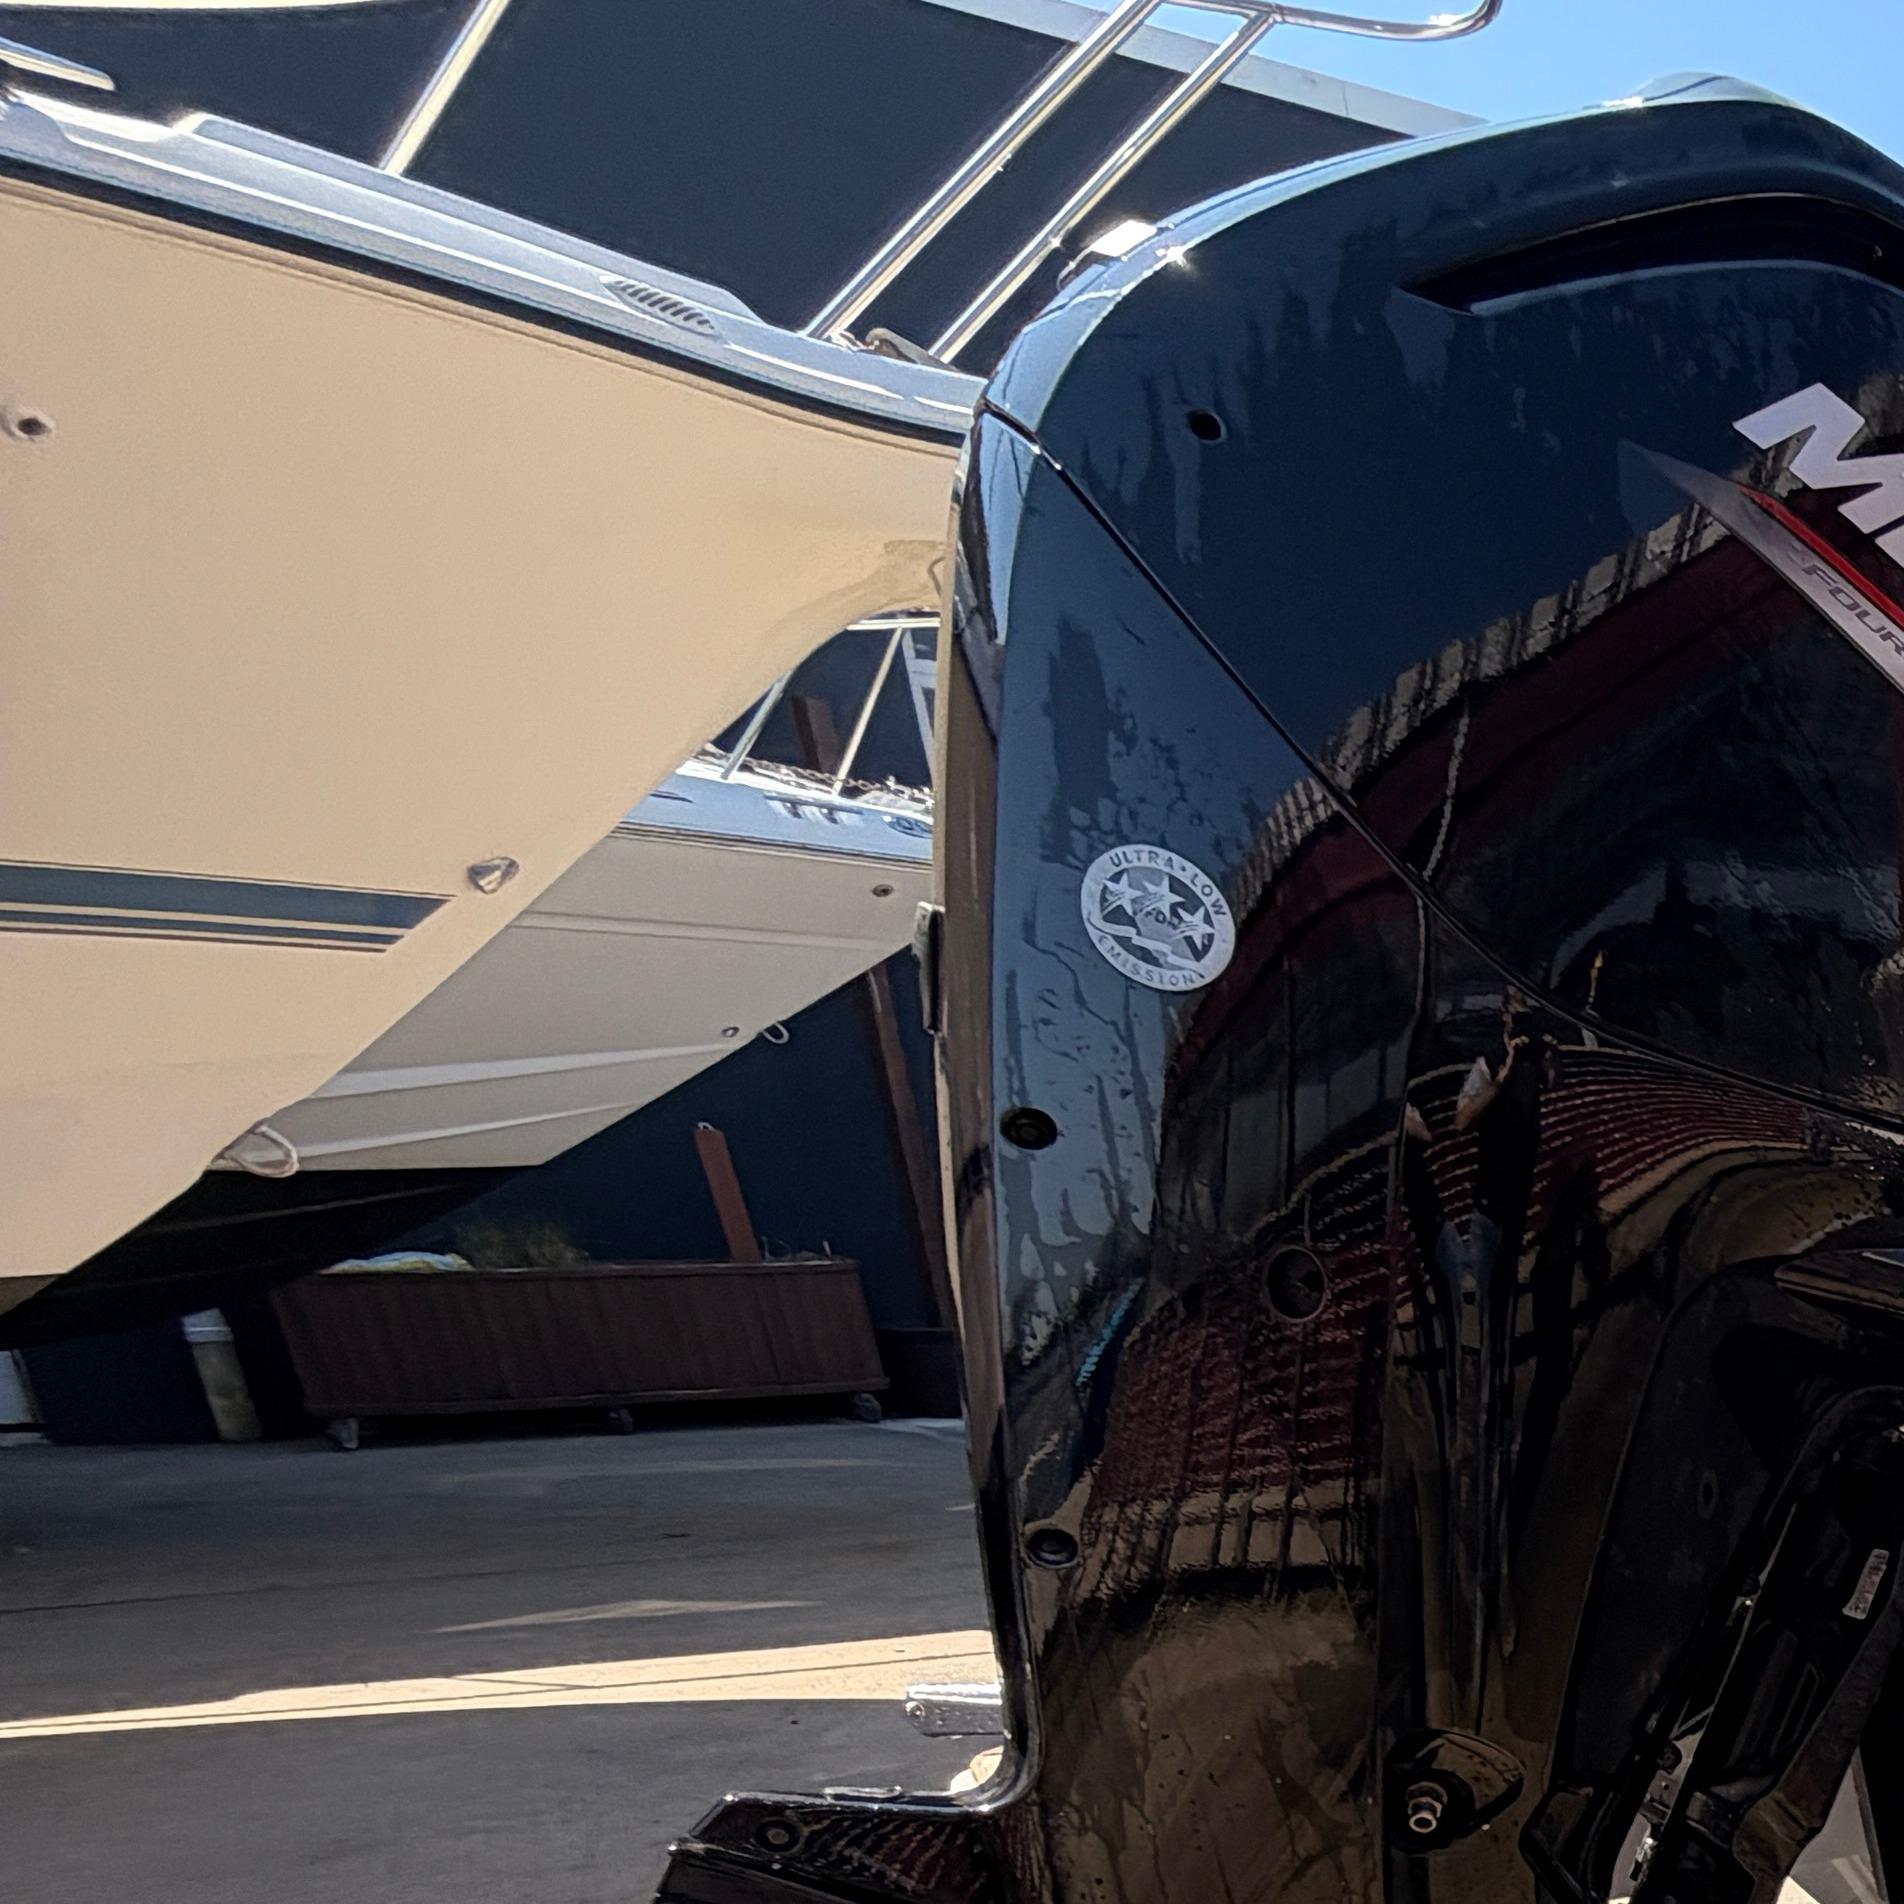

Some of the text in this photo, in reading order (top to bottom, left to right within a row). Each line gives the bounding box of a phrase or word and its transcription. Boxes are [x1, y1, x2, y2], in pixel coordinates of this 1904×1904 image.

[1109, 850, 1228, 917] ULTRA LOW
[1098, 935, 1196, 987] EMISSION
